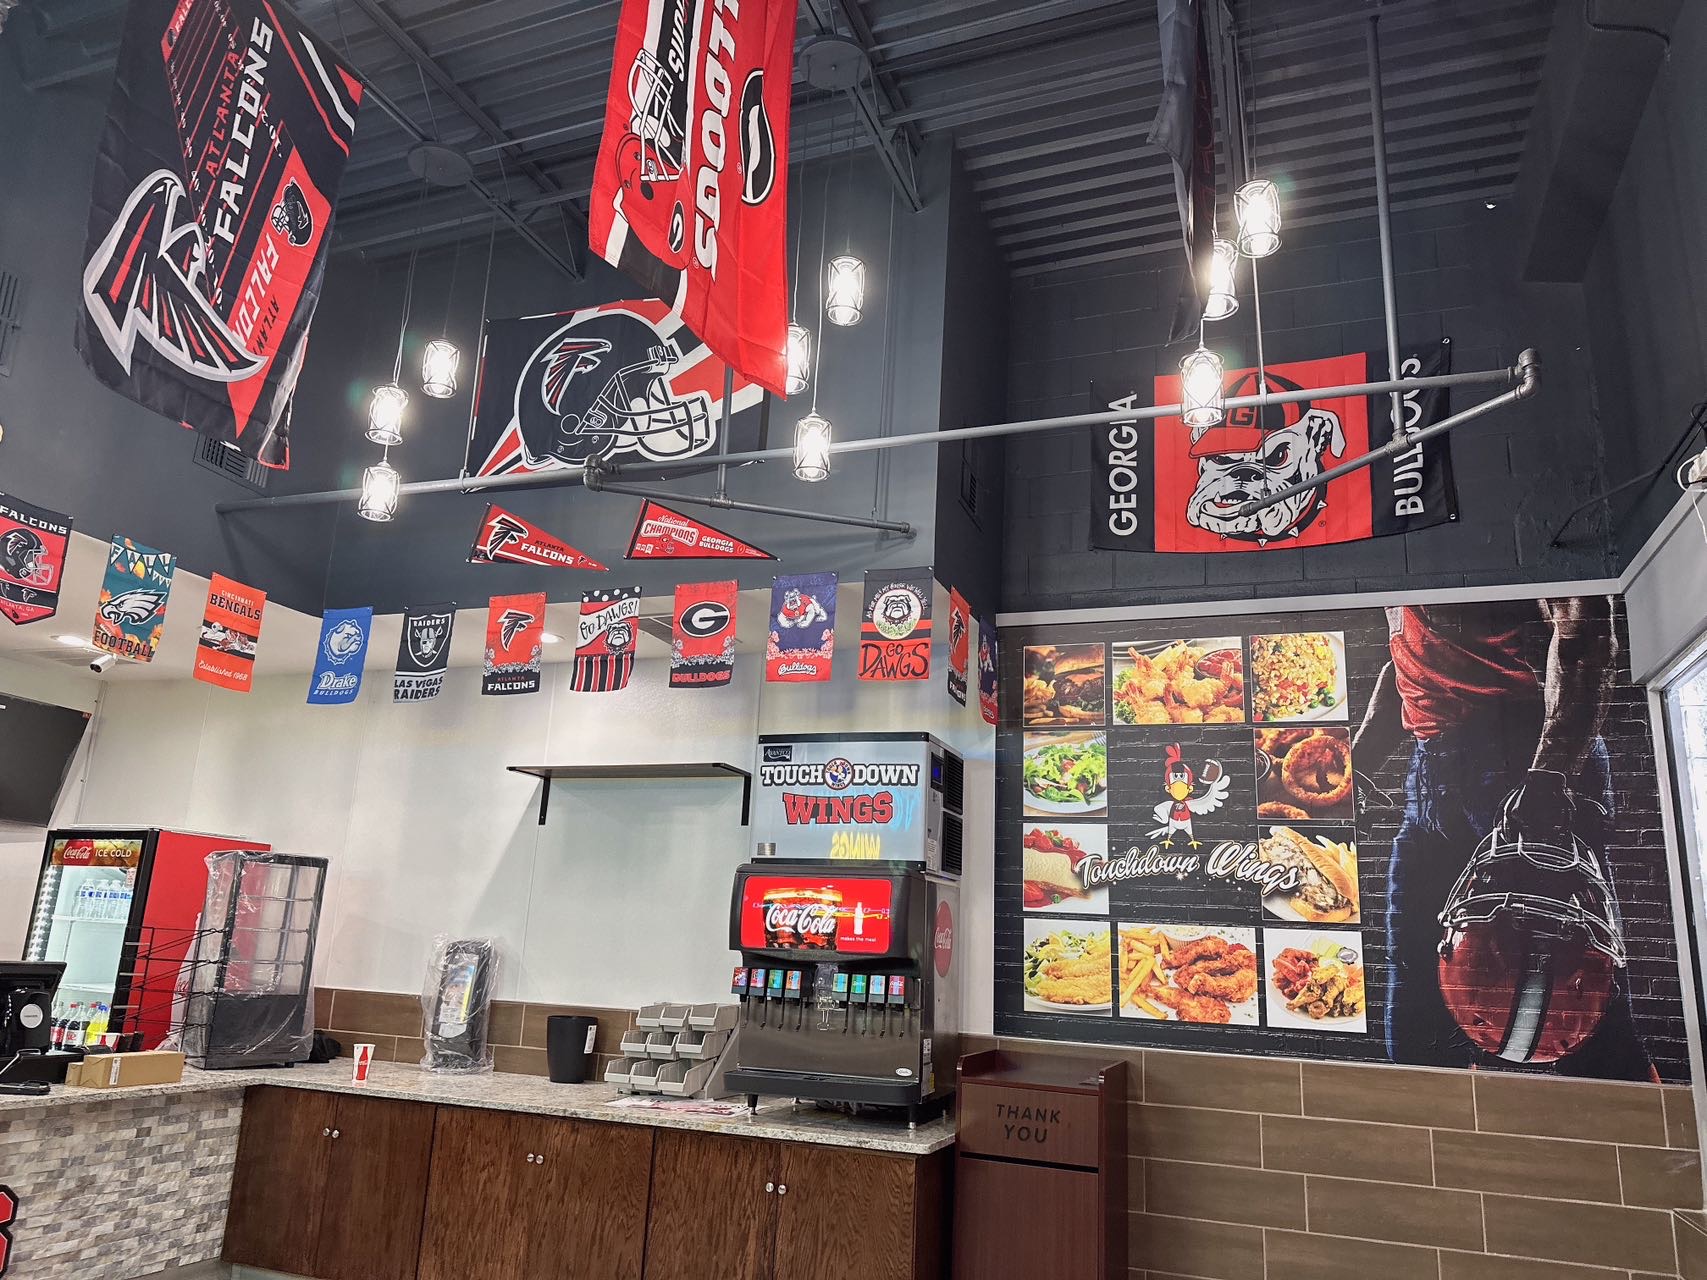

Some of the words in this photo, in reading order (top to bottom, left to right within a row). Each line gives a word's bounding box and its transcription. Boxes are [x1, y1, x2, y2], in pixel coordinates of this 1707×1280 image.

[205, 51, 240, 178] ATLANTA
[213, 17, 274, 245] FALCONS
[1108, 392, 1138, 536] GEORGIA
[0, 504, 67, 535] FALCONS
[658, 514, 690, 527] National
[643, 522, 696, 543] CHAMPIONS
[701, 535, 734, 547] GEORGIA
[521, 543, 574, 564] FALCONS
[535, 540, 564, 552] ATLANTA
[699, 541, 734, 553] BULLDOGS
[209, 593, 261, 620] BENGALS
[221, 590, 255, 606] CINCINNATI
[413, 617, 445, 627] RAIDERS
[94, 630, 154, 657] FOOTBALL
[885, 643, 904, 657] GO
[198, 659, 232, 679] Established
[233, 671, 248, 681] 1968
[778, 663, 817, 675] Bulldogs
[859, 642, 929, 678] DAWGS
[317, 671, 358, 690] Drake
[394, 679, 413, 688] LAS
[487, 680, 536, 691] FALCONS
[672, 671, 731, 682] BULLDOGS
[394, 686, 441, 699] RAIDERS
[761, 764, 825, 786] TOUCH
[853, 763, 920, 786] DOWN
[782, 791, 894, 825] WINGS
[95, 849, 108, 857] ICE
[110, 849, 132, 858] COLD
[1076, 845, 1200, 889] Touchdown
[1206, 840, 1301, 897] Wings
[996, 1103, 1061, 1124] THANK
[1004, 1124, 1048, 1144] YOU
